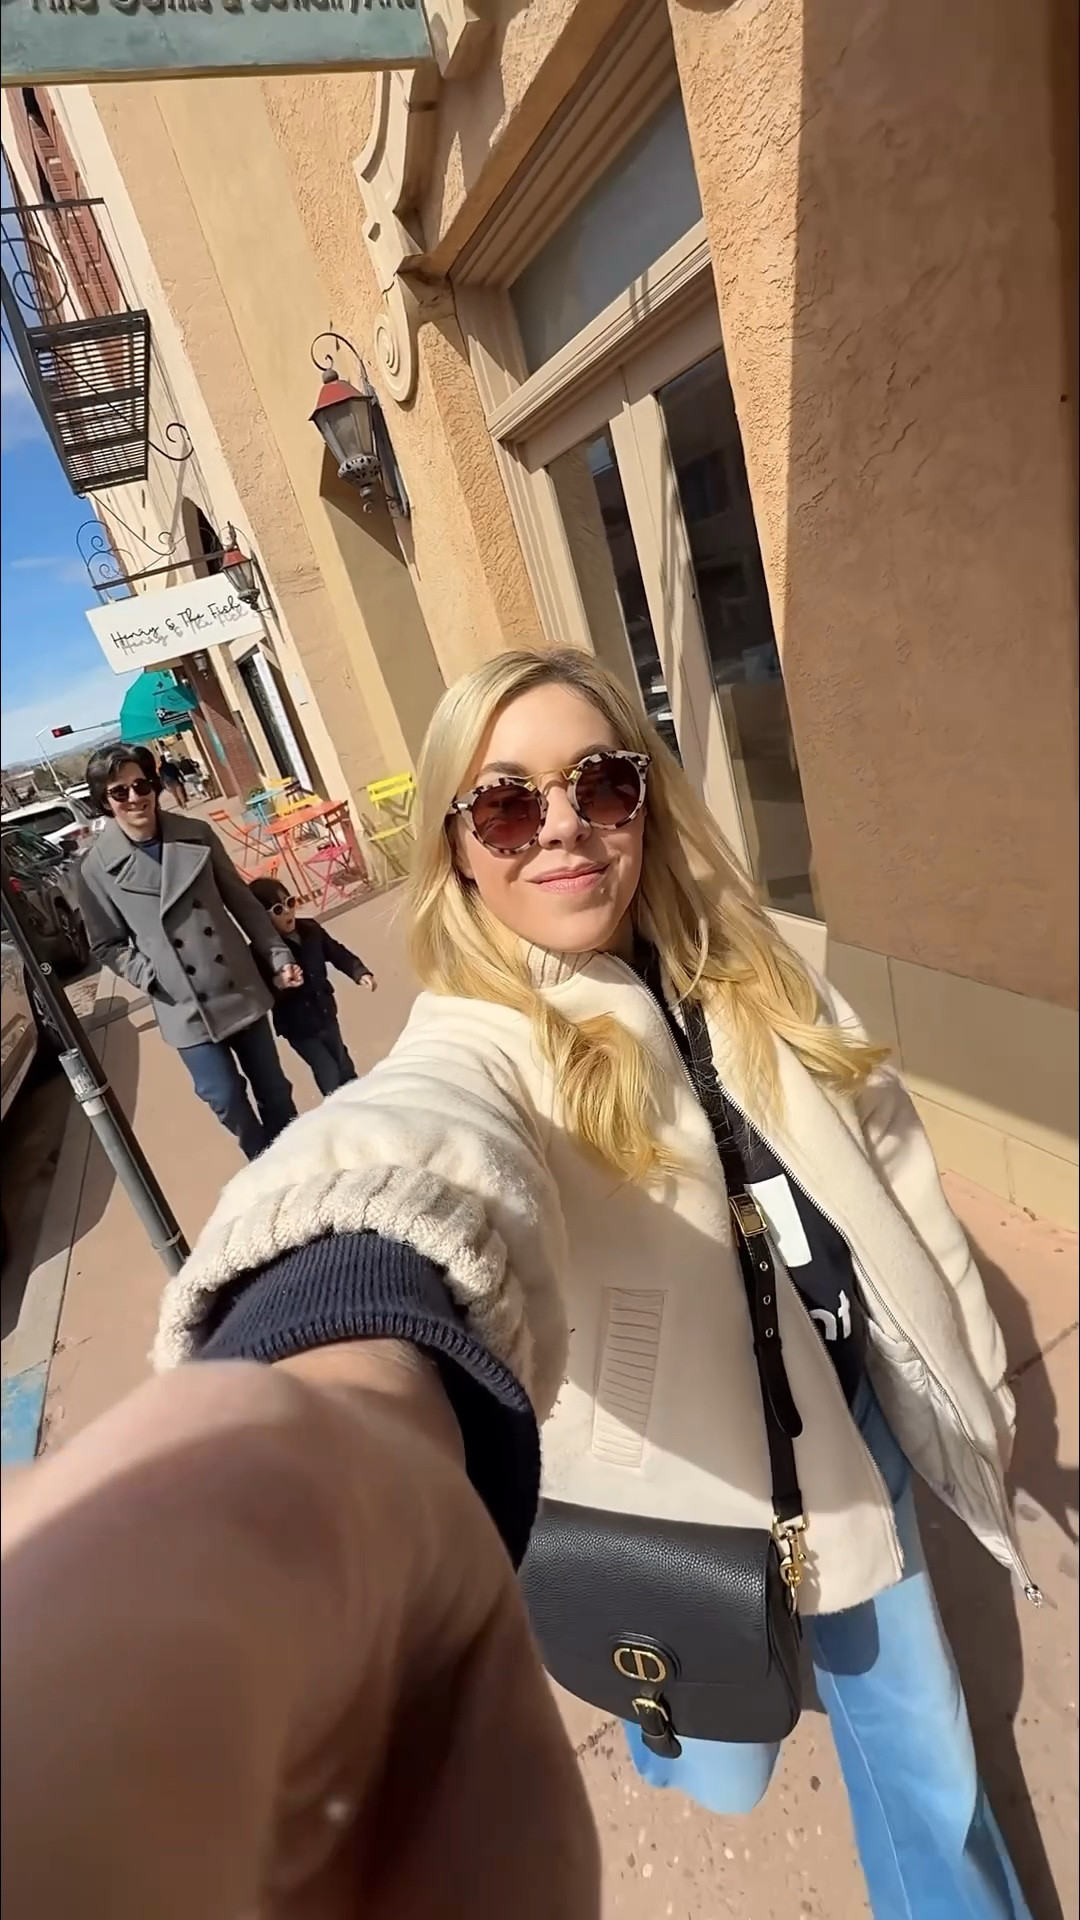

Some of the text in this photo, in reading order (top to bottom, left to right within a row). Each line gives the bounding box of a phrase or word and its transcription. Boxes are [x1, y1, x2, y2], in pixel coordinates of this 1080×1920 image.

[110, 626, 159, 648] Henry
[177, 608, 204, 627] The
[207, 595, 240, 619] Fish
